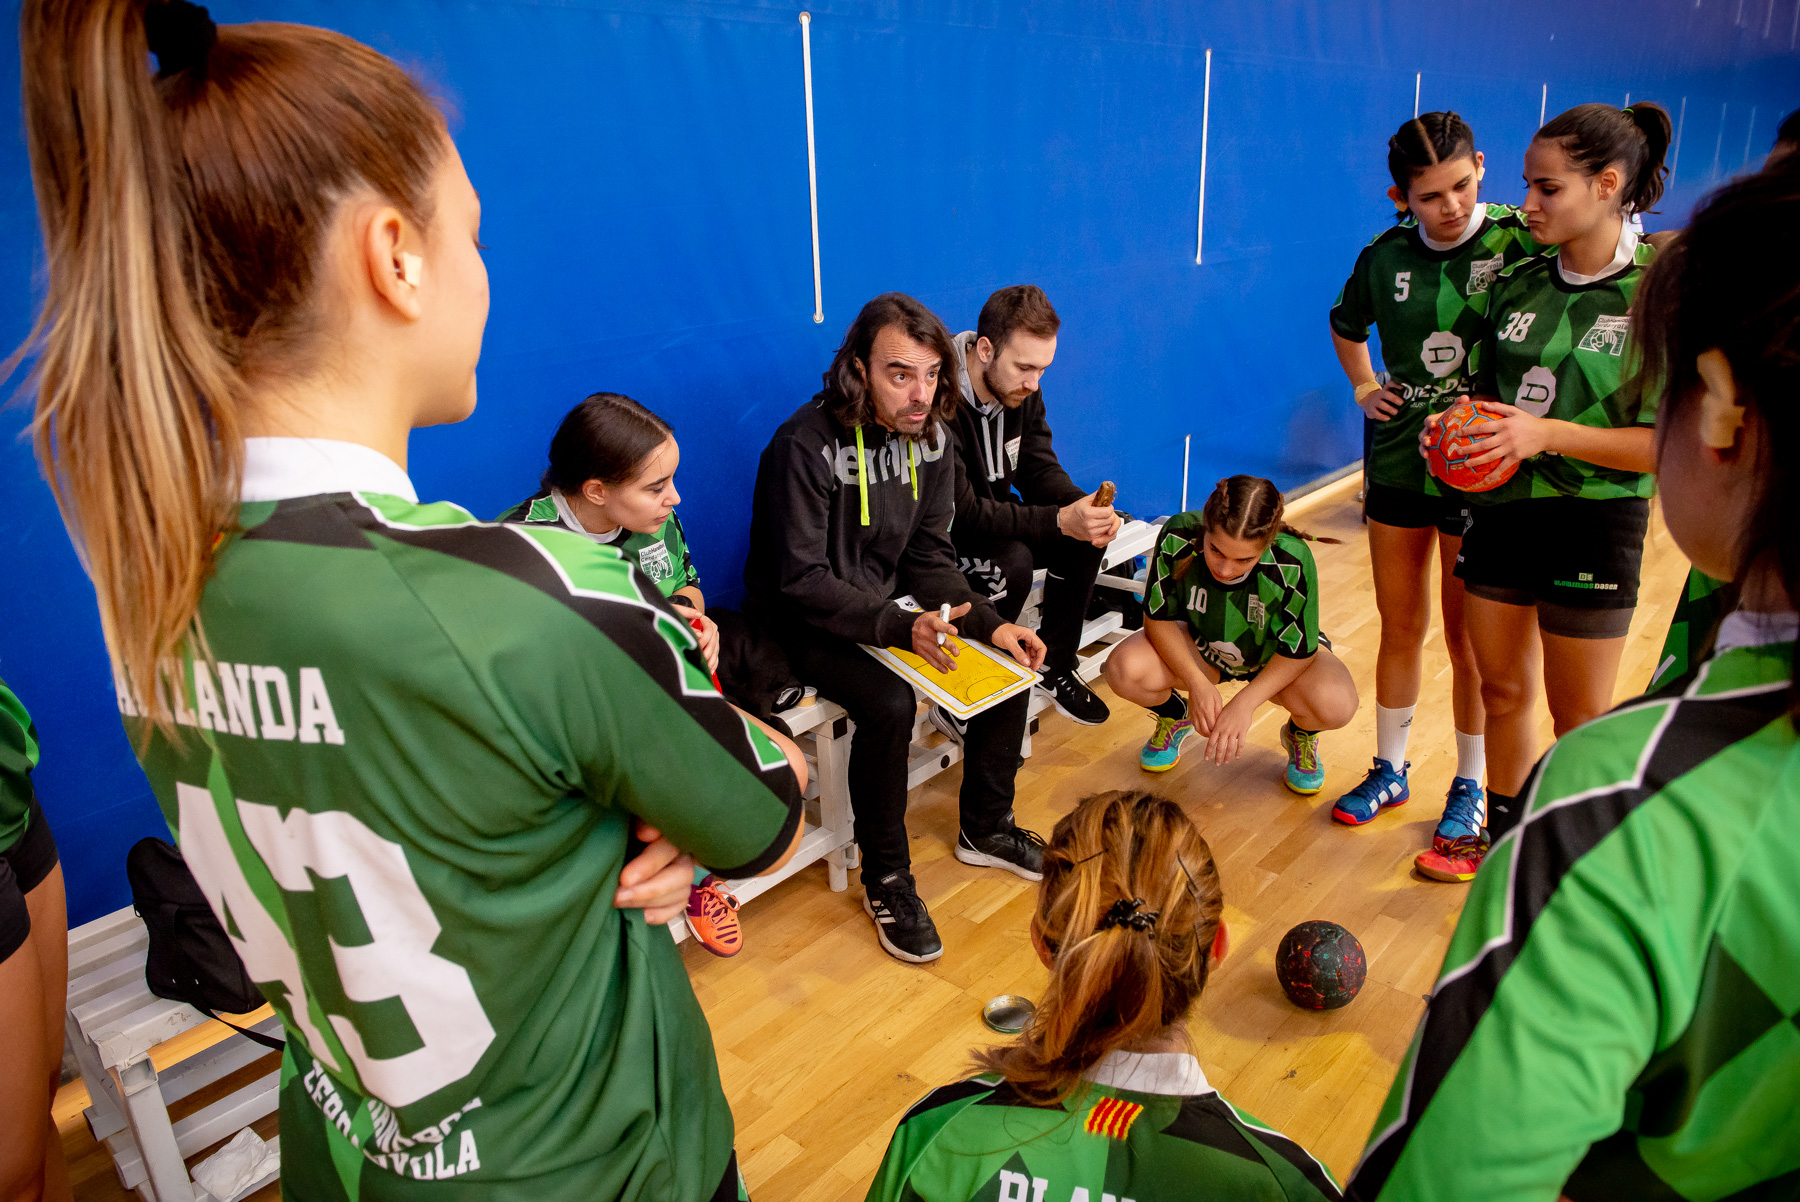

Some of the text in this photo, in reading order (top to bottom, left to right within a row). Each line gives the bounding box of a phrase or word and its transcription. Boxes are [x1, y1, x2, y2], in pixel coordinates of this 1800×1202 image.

[1394, 271, 1411, 302] 5
[1497, 311, 1536, 343] 38
[1428, 346, 1457, 364] D
[1520, 382, 1550, 403] D
[1186, 585, 1208, 614] 10
[175, 780, 497, 1108] 43
